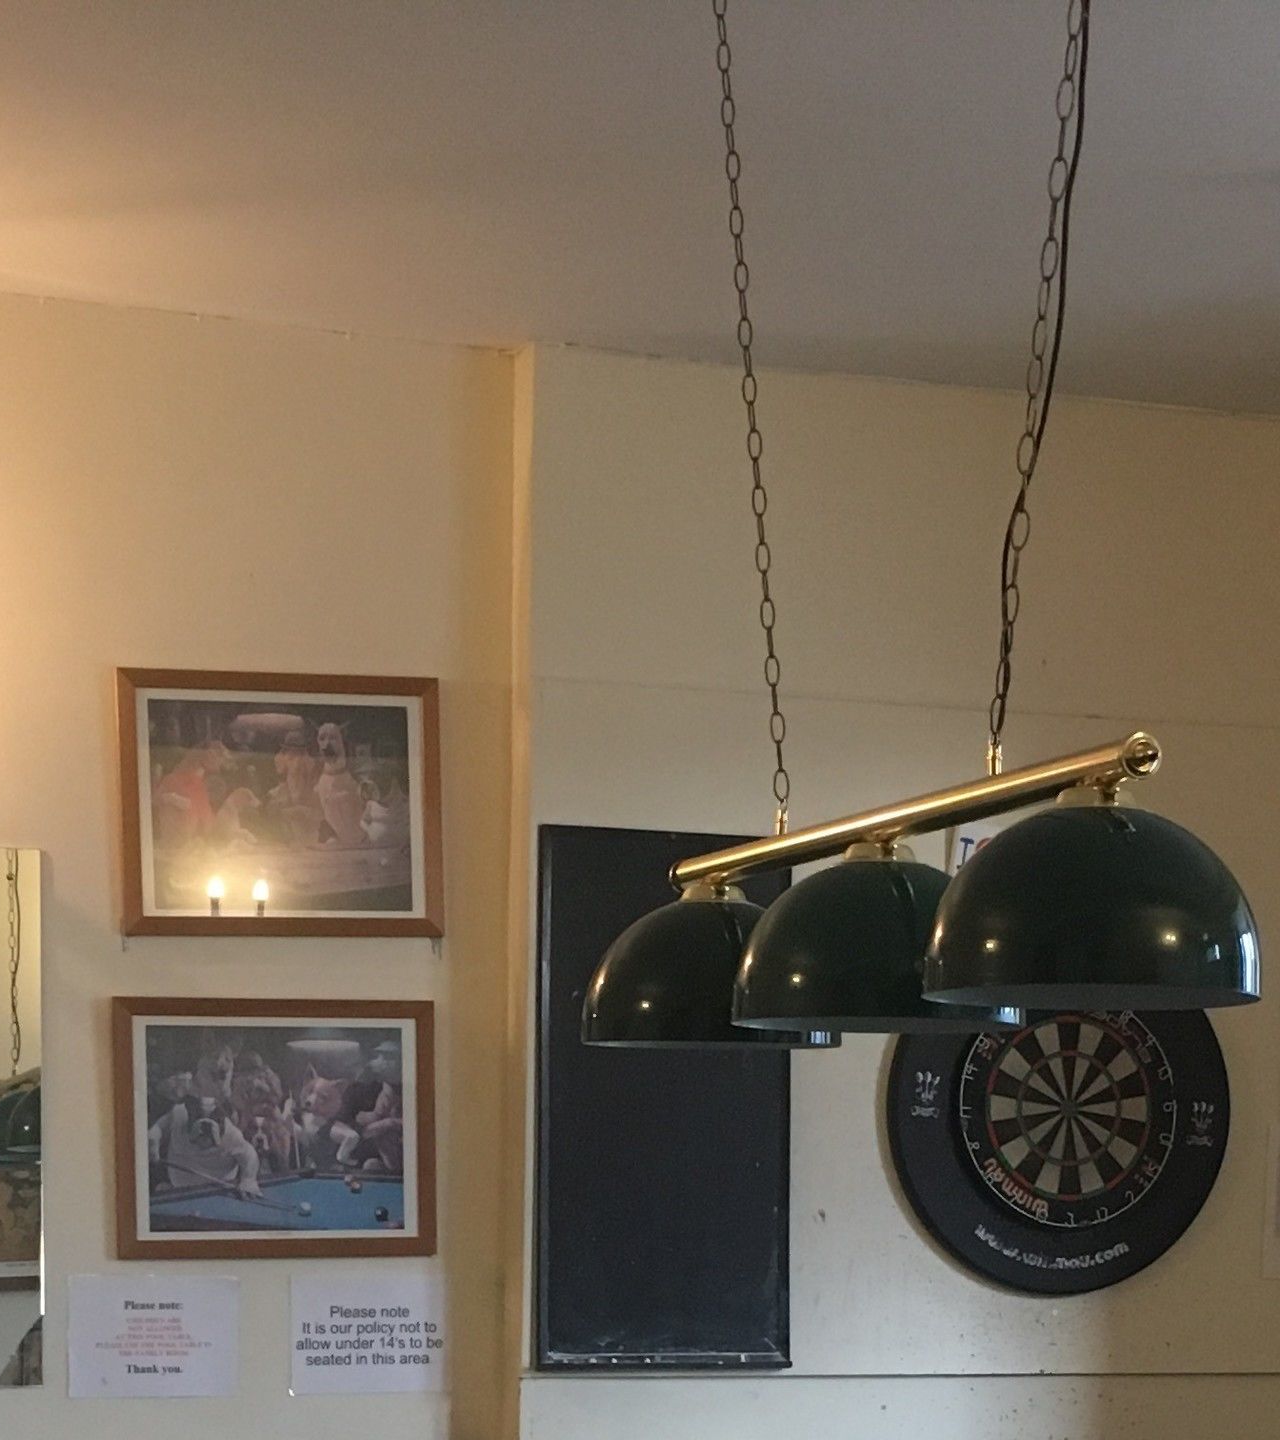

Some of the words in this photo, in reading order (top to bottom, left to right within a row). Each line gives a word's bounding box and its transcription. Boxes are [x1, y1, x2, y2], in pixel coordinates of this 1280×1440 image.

[124, 1300, 156, 1310] Please
[330, 1305, 376, 1318] Please
[381, 1306, 410, 1318] note
[302, 1322, 311, 1334] It
[315, 1322, 326, 1334] is
[330, 1324, 352, 1334] our
[356, 1321, 396, 1336] policy
[399, 1322, 421, 1333] not
[424, 1321, 437, 1333] to
[296, 1338, 331, 1350] allow
[335, 1338, 375, 1350] under
[379, 1336, 405, 1349] 14's
[410, 1337, 422, 1348] to
[426, 1336, 443, 1349] be
[306, 1353, 352, 1366] seated
[356, 1353, 367, 1365] in
[371, 1353, 395, 1365] this
[399, 1354, 430, 1365] area
[126, 1364, 159, 1374] Thank
